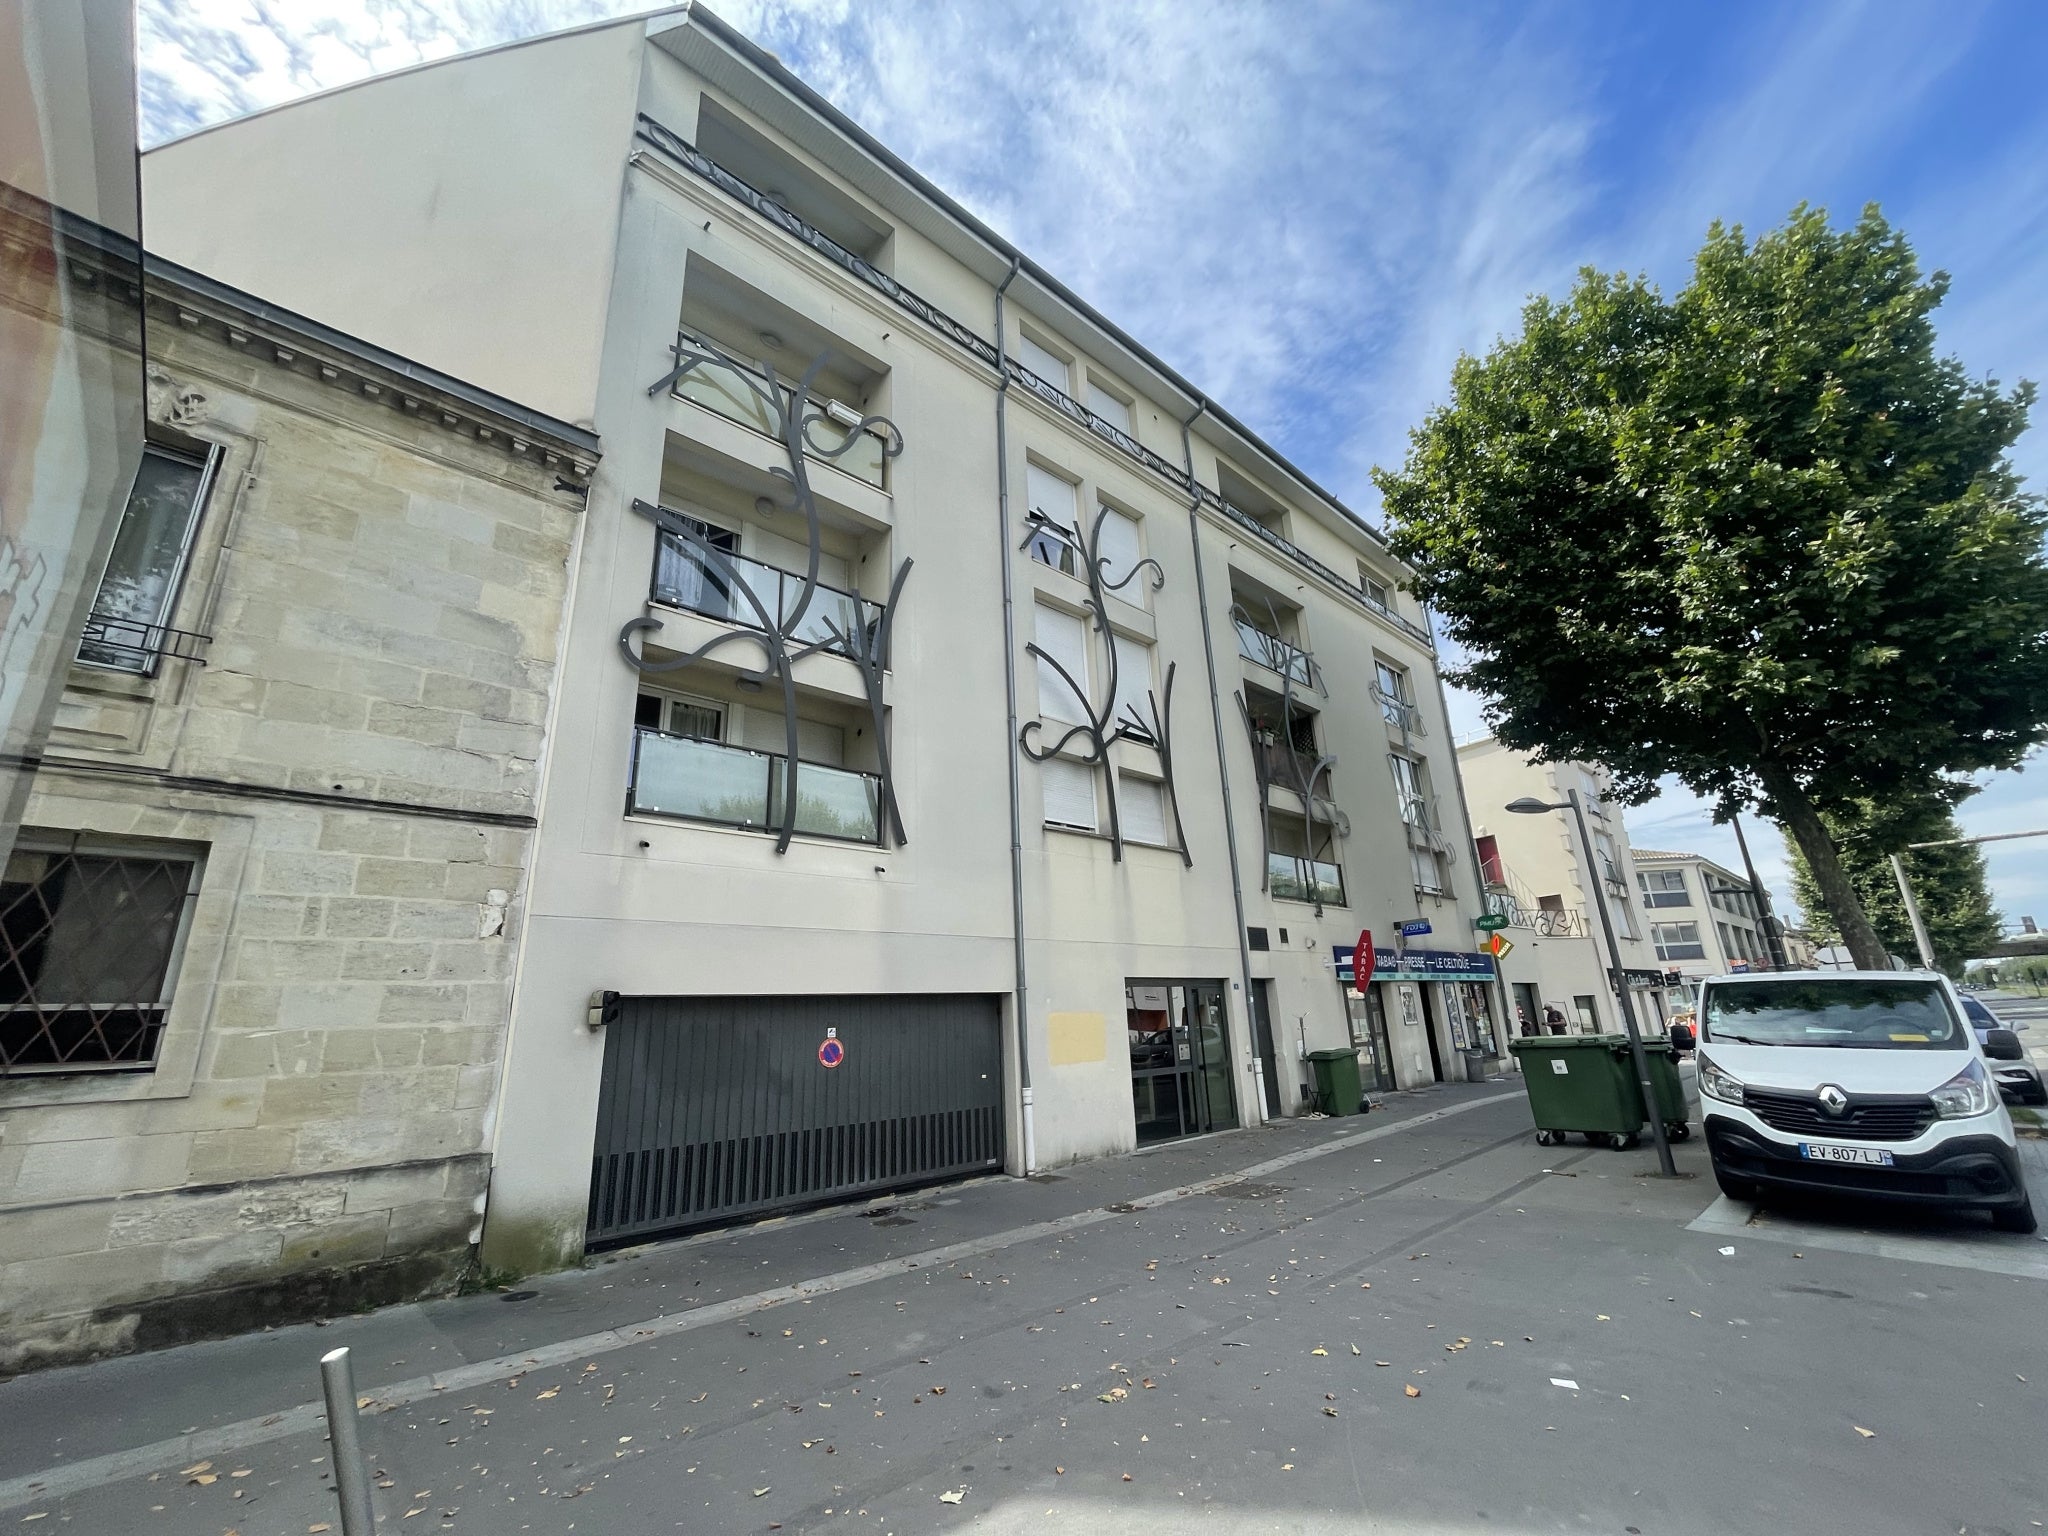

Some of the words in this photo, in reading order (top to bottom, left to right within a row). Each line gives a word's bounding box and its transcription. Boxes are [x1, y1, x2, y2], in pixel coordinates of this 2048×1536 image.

[1406, 923, 1419, 931] FDJ
[1360, 942, 1368, 980] TABAC
[1376, 955, 1397, 968] TABAC
[1403, 956, 1426, 968] PRESSE
[1435, 958, 1444, 969] LE
[1443, 959, 1471, 970] CELTIQUE
[1808, 1145, 1884, 1164] EV-807-LJ
